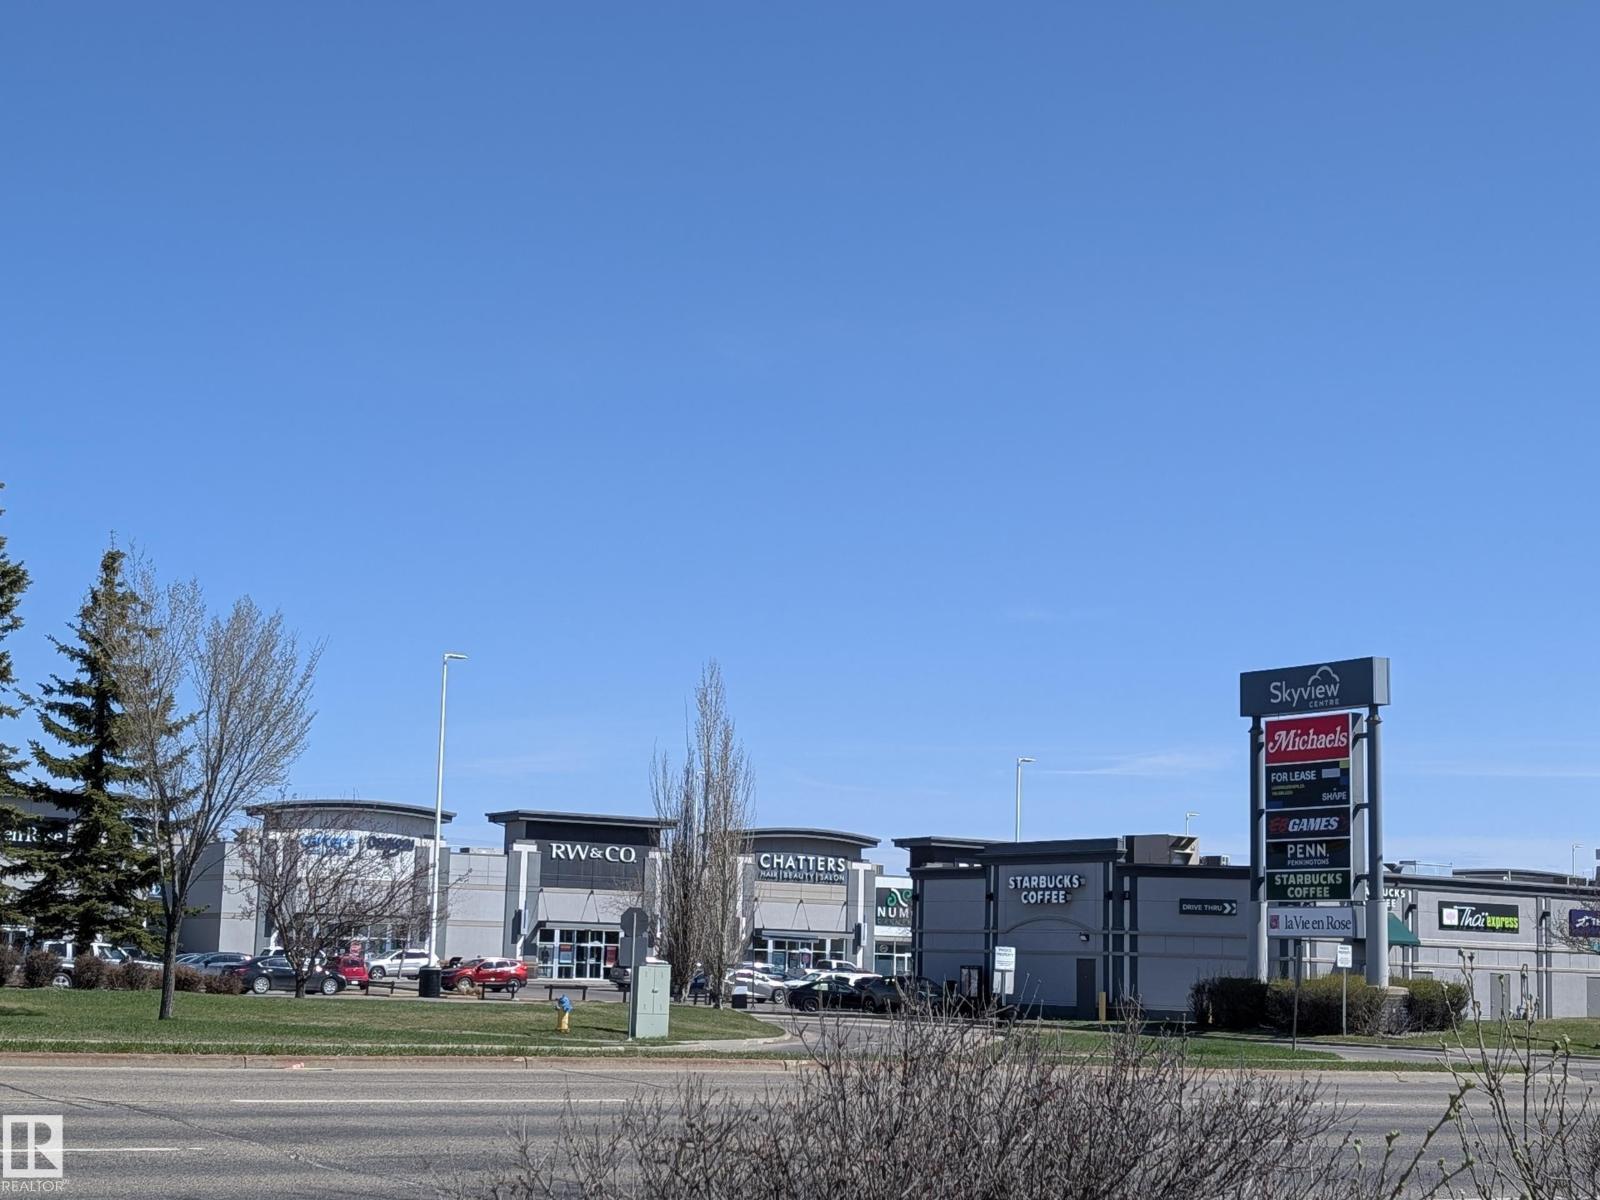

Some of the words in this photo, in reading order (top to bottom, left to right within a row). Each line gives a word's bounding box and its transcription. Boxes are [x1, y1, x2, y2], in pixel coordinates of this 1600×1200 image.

[1270, 681, 1340, 708] Skyview
[1308, 698, 1340, 708] CENTRE
[1267, 725, 1348, 754] Michaels
[1271, 772, 1289, 782] FOR
[1289, 770, 1317, 782] LEASE
[1287, 816, 1340, 832] GAMES
[760, 853, 846, 872] CHATTERS
[760, 870, 778, 879] HAIR
[783, 871, 815, 881] BEAUTY
[1008, 875, 1080, 889] STARBUCKS
[1274, 873, 1343, 885] STARBUCKS
[1021, 890, 1067, 904] COFFEE
[1287, 886, 1330, 898] COFFEE
[877, 906, 913, 919] NUM
[1182, 903, 1203, 911] DRIVE
[1203, 904, 1223, 912] THRU
[1311, 919, 1324, 930] en
[1326, 915, 1352, 931] Rose
[1486, 915, 1518, 929] express
